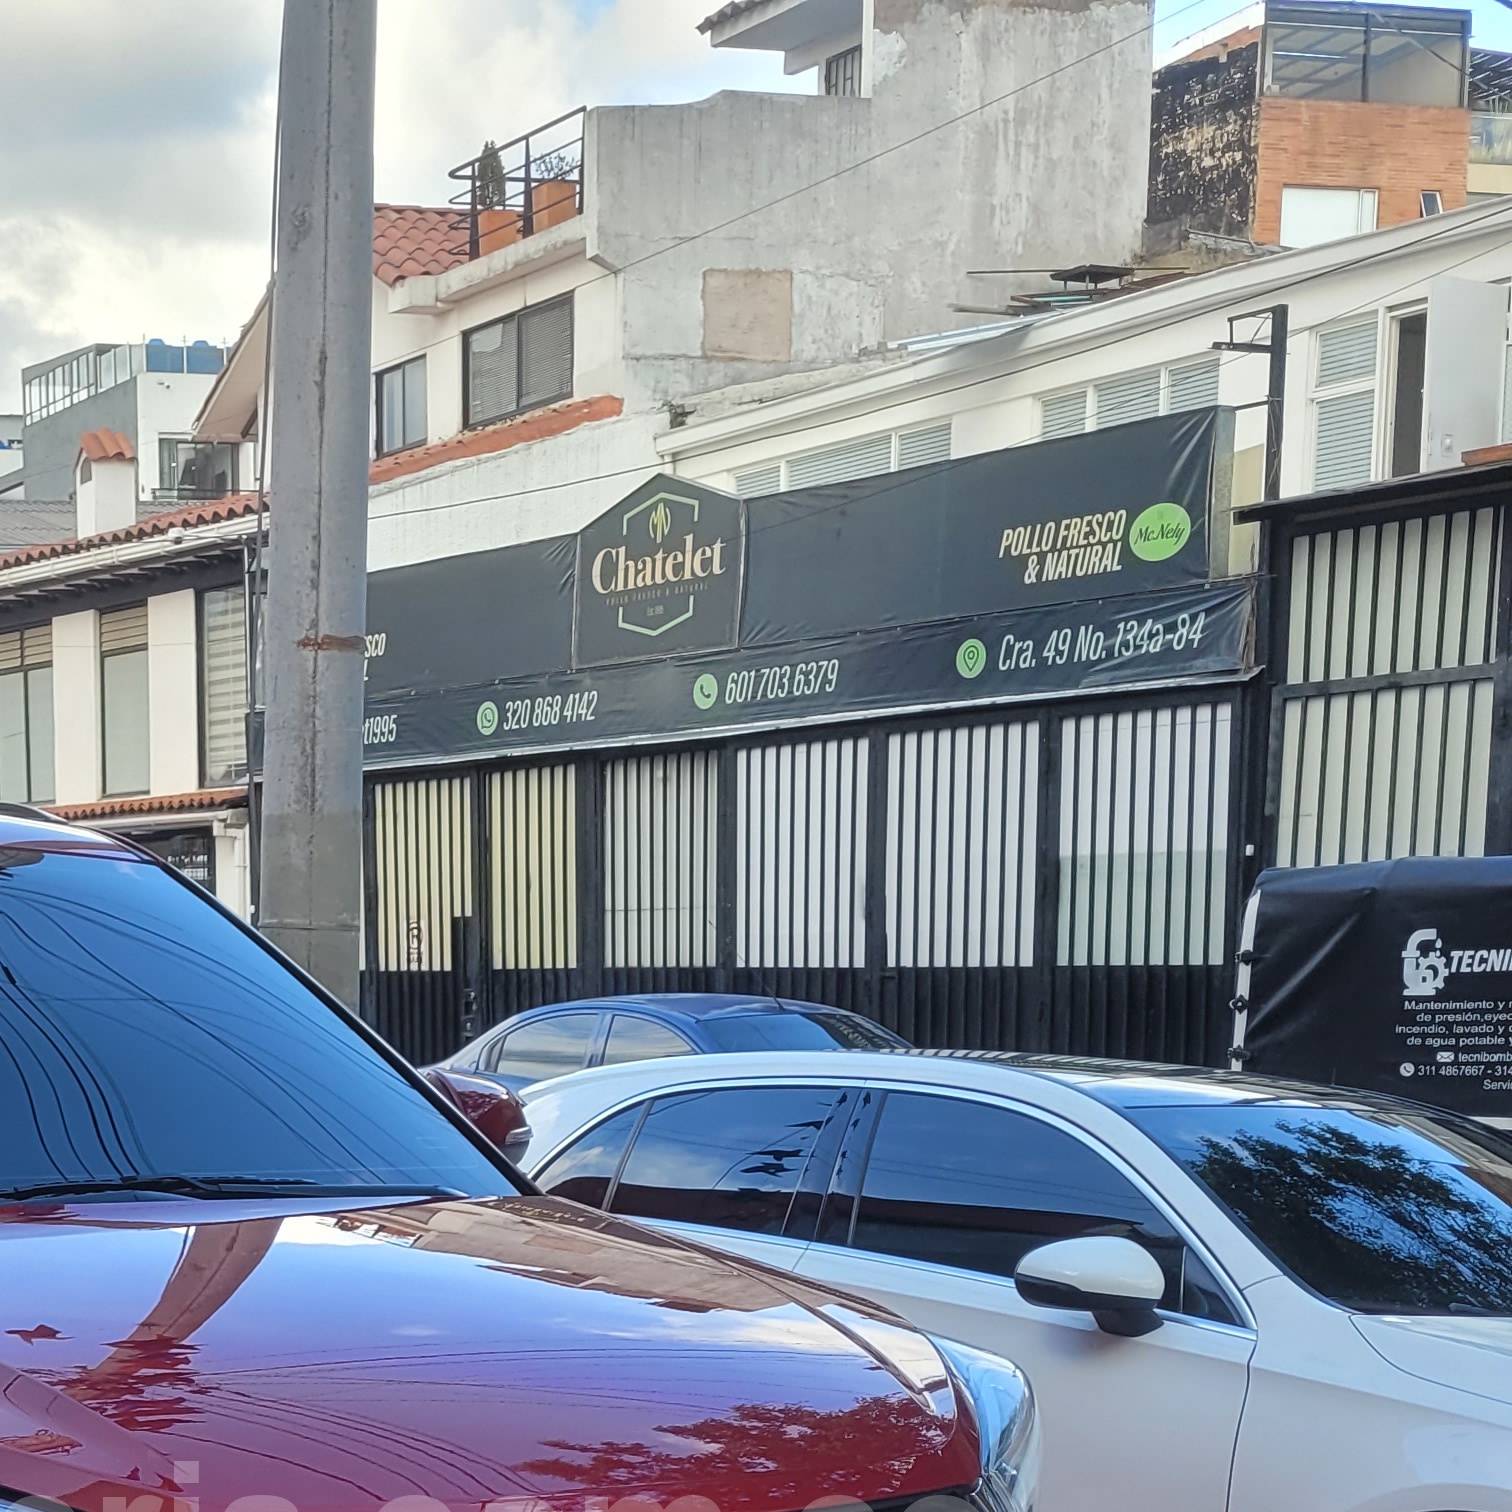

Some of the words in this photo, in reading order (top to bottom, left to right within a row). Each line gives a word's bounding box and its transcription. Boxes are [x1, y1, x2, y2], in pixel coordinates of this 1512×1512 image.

[999, 521, 1055, 558] POLLO
[1057, 509, 1127, 549] FRESCO
[591, 533, 727, 594] Chatelet
[1024, 555, 1040, 584] &
[1042, 541, 1122, 582] NATURAL
[998, 634, 1037, 671] Cra.
[1042, 628, 1071, 665] 49
[1073, 624, 1106, 662] No.
[1113, 612, 1207, 658] 134a-84
[725, 670, 756, 704] 601
[756, 665, 791, 700] 703
[793, 659, 839, 696] 6379
[503, 699, 531, 730] 320
[532, 695, 562, 727] 868
[563, 690, 598, 723] 4142
[362, 714, 398, 745] t1995
[1403, 1000, 1494, 1010] Mantenimiento
[1497, 1001, 1506, 1011] y
[1416, 1013, 1432, 1022] de
[1406, 1036, 1422, 1045] de
[1425, 1038, 1456, 1047] agua
[1459, 1036, 1506, 1047] potable
[1453, 1024, 1494, 1034] lavado
[1497, 1025, 1506, 1035] y
[1417, 1066, 1436, 1076] 311
[1438, 1066, 1485, 1076] 4867667
[1483, 1079, 1512, 1090] Servi
